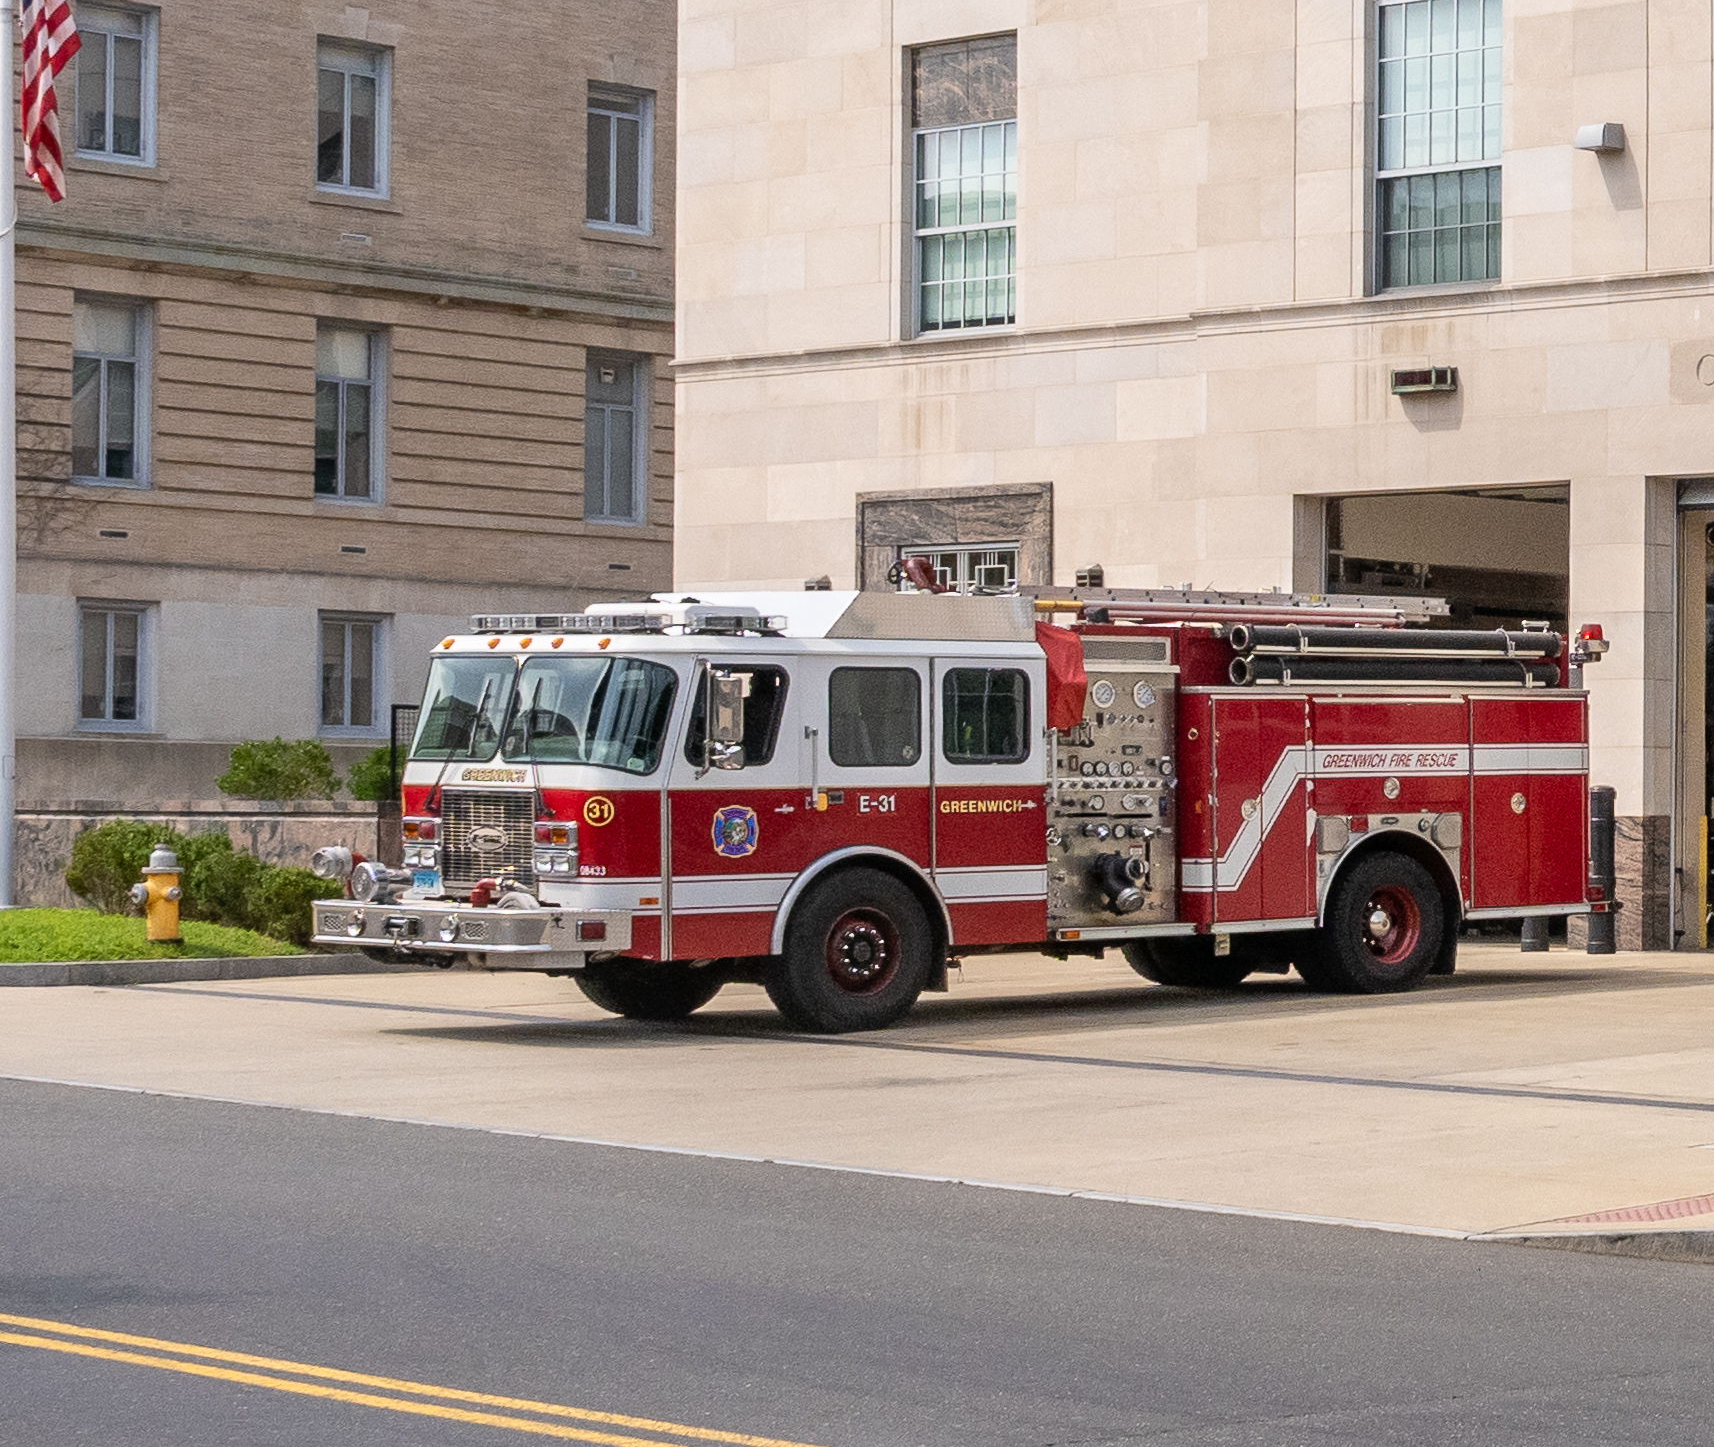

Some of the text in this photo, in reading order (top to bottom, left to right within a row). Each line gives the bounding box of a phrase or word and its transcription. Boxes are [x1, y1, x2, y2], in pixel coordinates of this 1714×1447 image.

[1323, 753, 1459, 768] GREENWICH FIRE RESCUE
[461, 767, 528, 783] GREENWICH
[588, 803, 609, 819] 31
[859, 795, 895, 813] E-31
[940, 800, 1022, 813] GREENWICH
